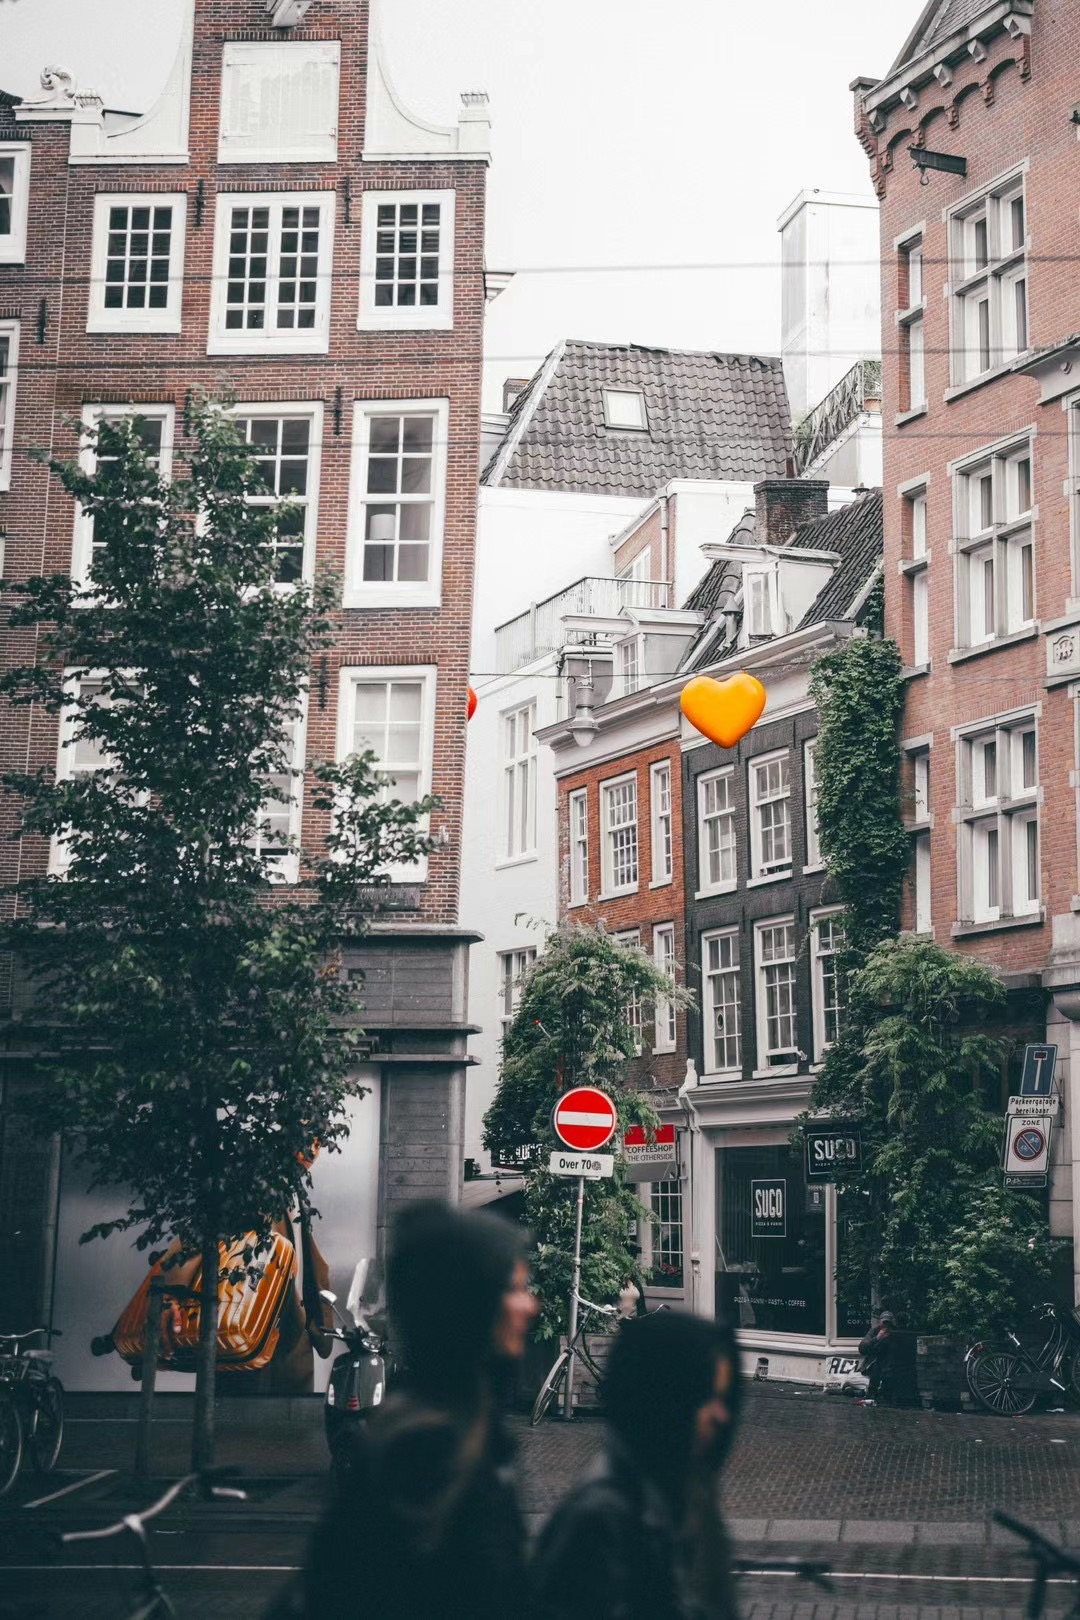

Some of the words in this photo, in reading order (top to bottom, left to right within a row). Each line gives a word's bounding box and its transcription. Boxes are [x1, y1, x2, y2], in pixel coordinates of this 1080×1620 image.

[1011, 1098, 1056, 1106] Parkeergarage
[627, 1144, 673, 1154] COFFEESHOP
[640, 1153, 673, 1161] OTHERSIDE
[559, 1158, 579, 1169] Over
[755, 1188, 783, 1218] SUGO
[787, 1299, 806, 1307] COFFEE
